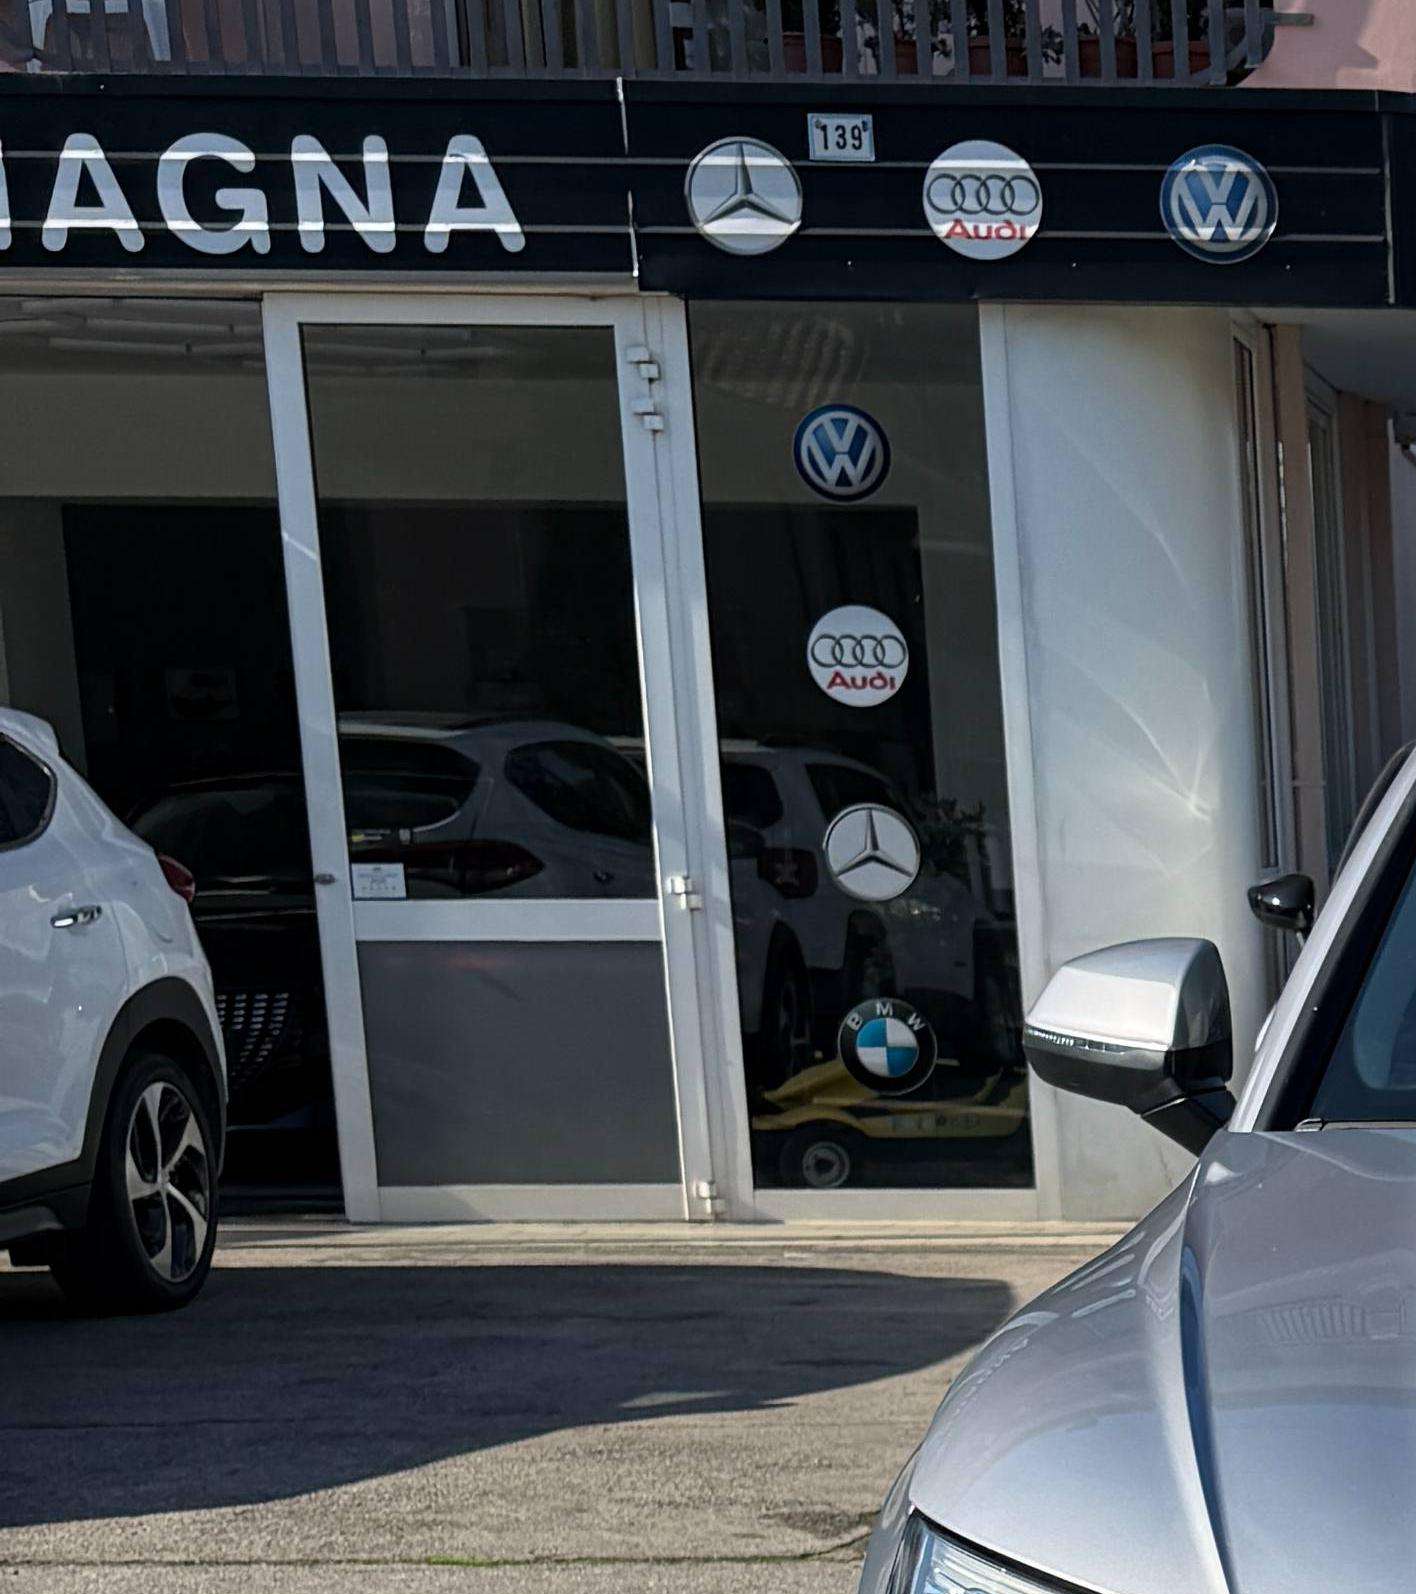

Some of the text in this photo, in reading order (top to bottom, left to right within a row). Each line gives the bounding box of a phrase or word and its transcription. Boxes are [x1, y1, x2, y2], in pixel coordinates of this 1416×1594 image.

[0, 132, 526, 255] AGNA
[944, 218, 1028, 241] Audi
[826, 670, 897, 690] Audi
[846, 1001, 927, 1032] BMW
